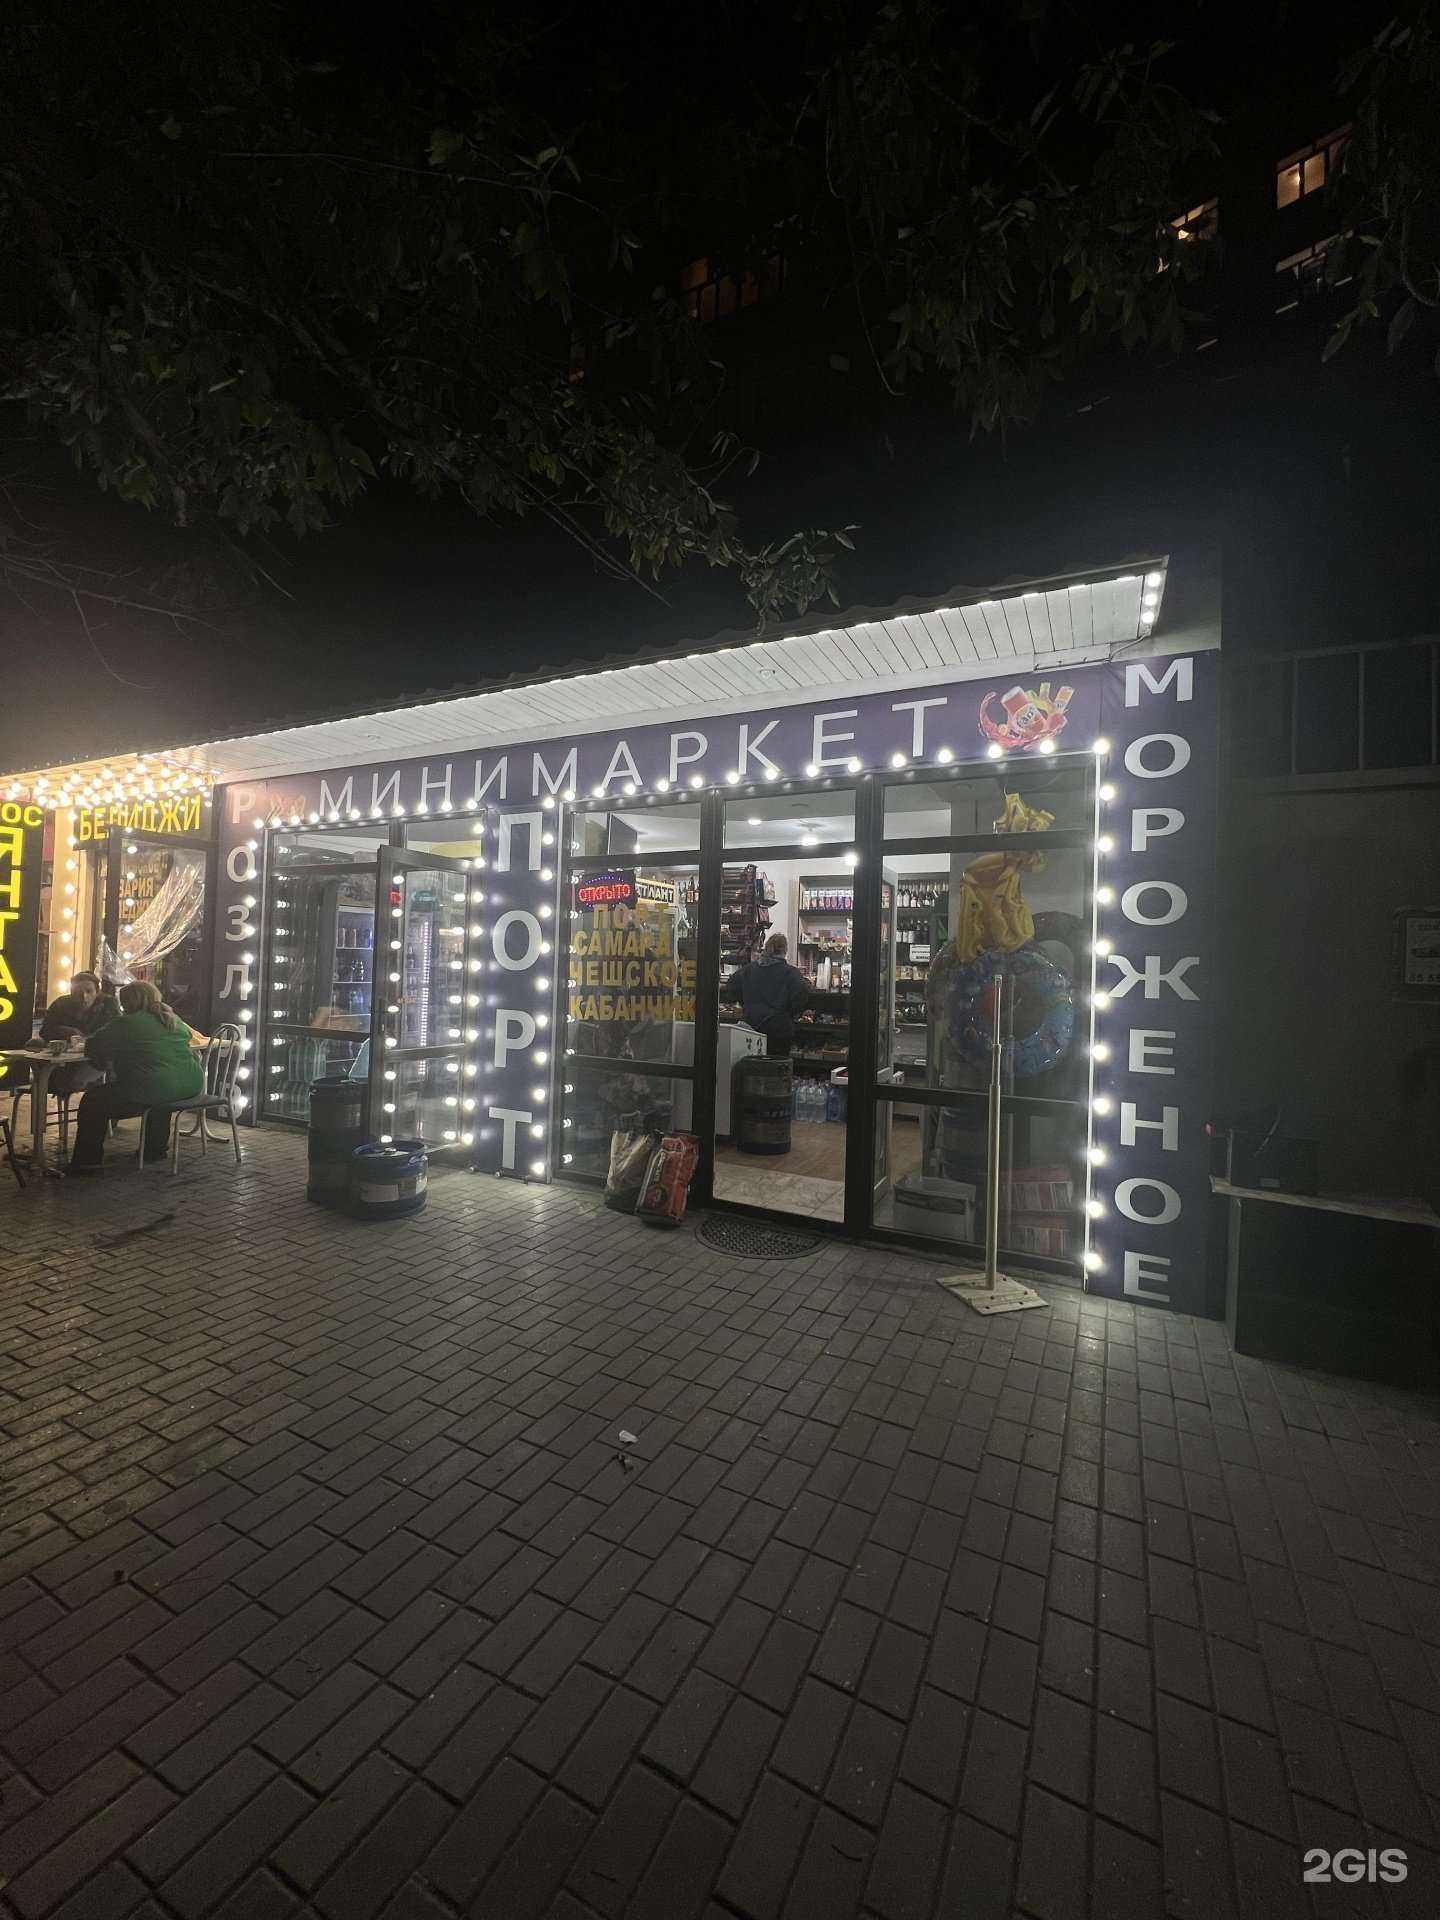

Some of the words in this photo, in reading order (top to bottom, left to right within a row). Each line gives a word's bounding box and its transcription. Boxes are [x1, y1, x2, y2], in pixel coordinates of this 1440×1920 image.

[319, 697, 948, 817] МИНИМАРКЕТ
[578, 883, 631, 902] ОТКРЫТО
[592, 904, 670, 929] ПОРТ
[573, 930, 672, 957] САМАРА
[569, 960, 697, 987] ЧЕШСКОЕ
[1108, 657, 1201, 1302] МОРОЖЕНОЕ
[487, 811, 544, 1170] ПОРТ
[568, 995, 697, 1021] КАБАНЧИК
